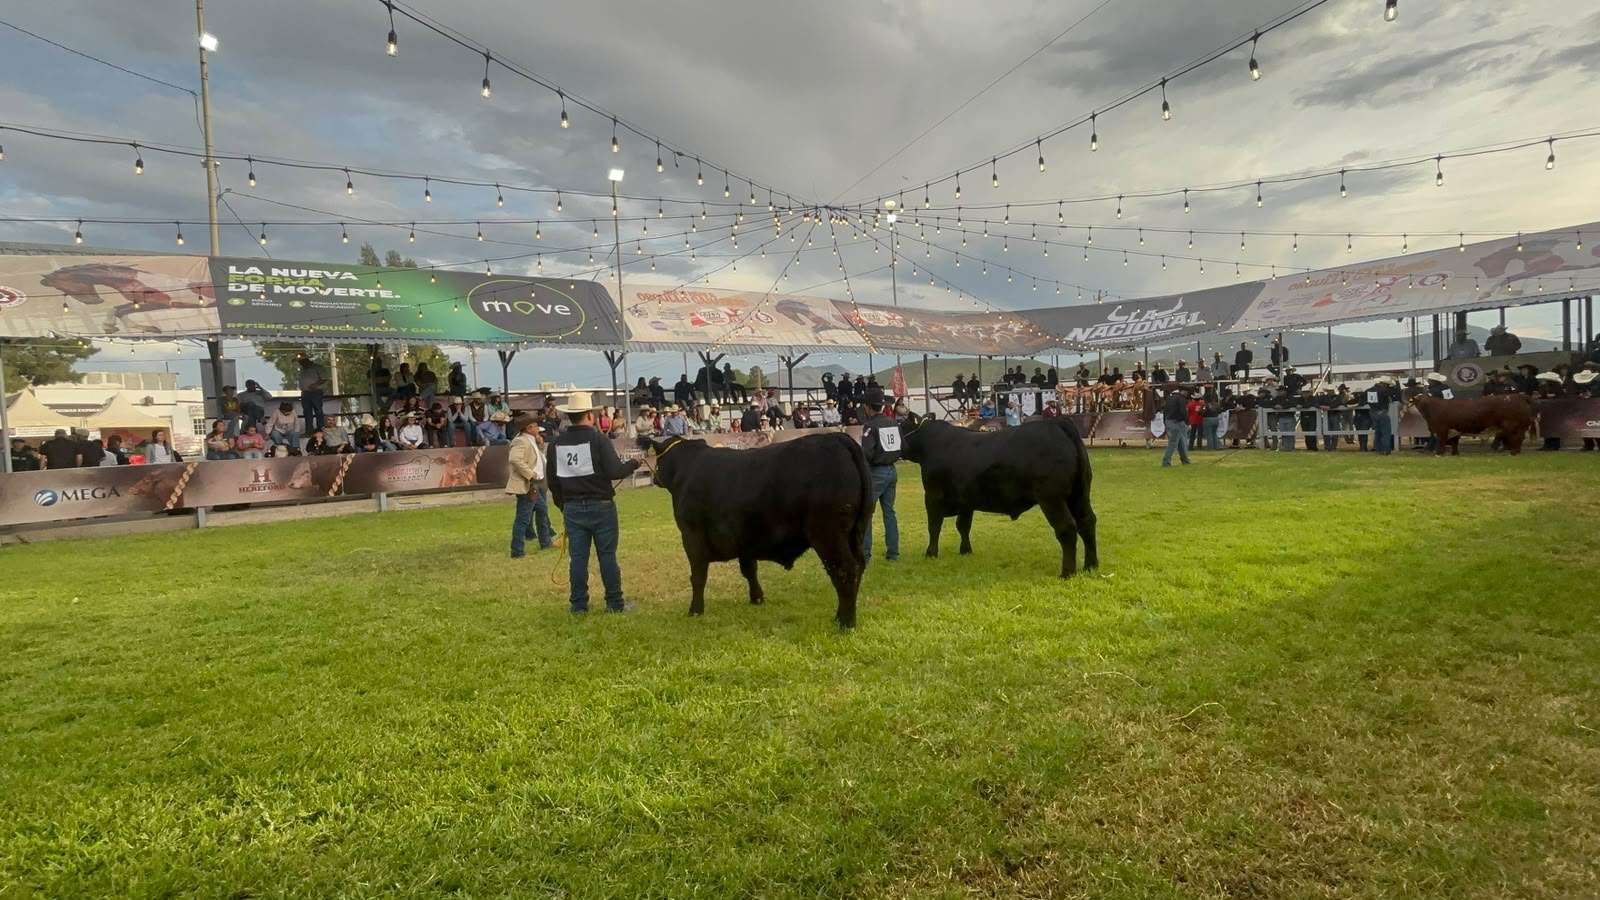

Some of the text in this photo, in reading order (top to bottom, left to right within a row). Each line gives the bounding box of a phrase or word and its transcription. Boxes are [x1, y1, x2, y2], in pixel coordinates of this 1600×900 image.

[229, 266, 359, 280] LA NUEVA
[229, 274, 325, 287] FORMA
[228, 283, 401, 299] DE MOVERTE.
[482, 300, 572, 316] move
[1063, 311, 1204, 341] NACIONAL
[887, 434, 895, 445] 18
[567, 452, 578, 466] 24
[61, 486, 121, 502] MEGA
